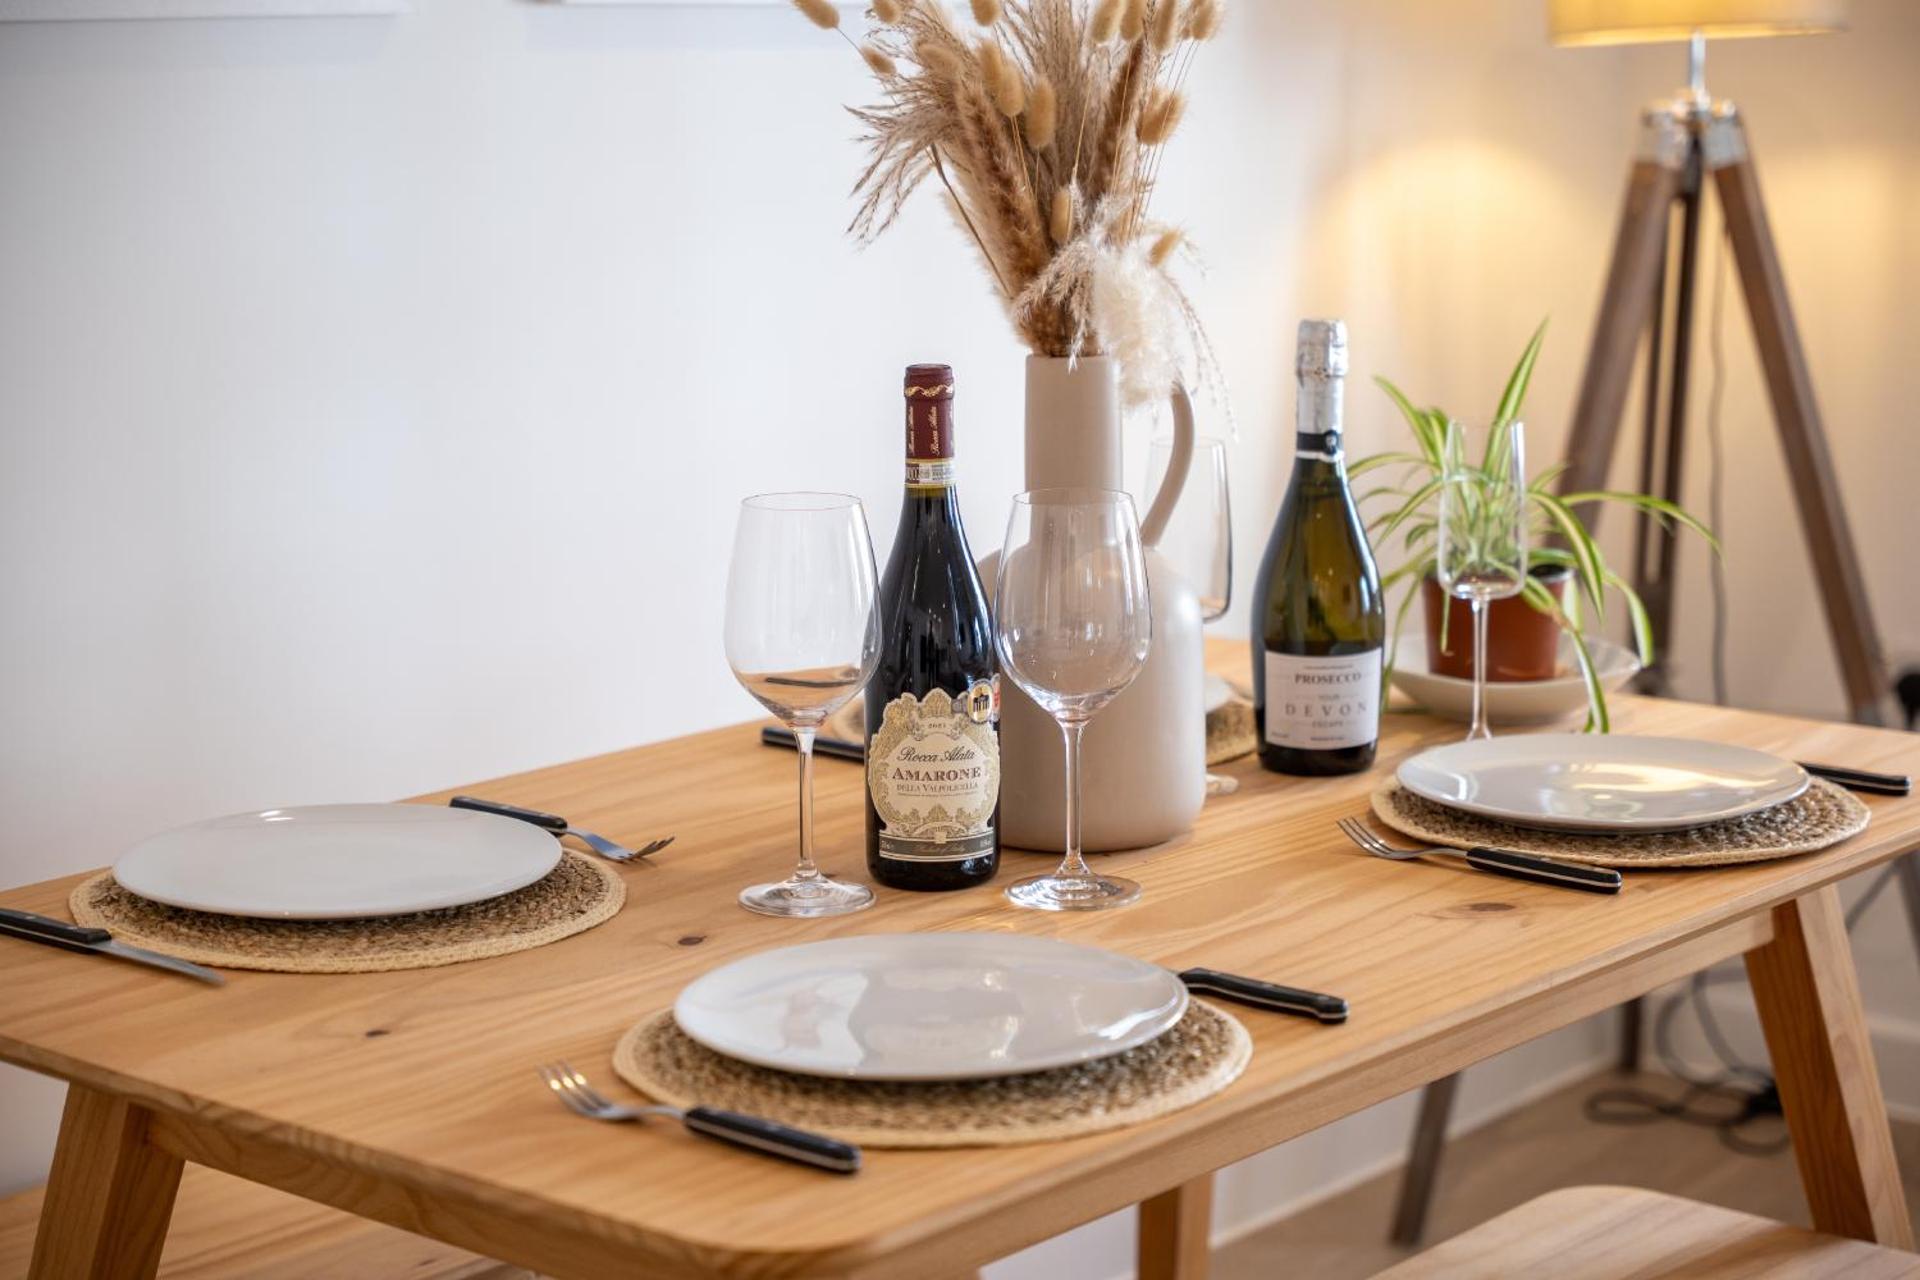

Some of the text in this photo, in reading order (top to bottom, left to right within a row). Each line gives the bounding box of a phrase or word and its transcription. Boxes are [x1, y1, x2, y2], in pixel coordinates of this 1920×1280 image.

[1295, 673, 1361, 684] PROSECCO
[1285, 702, 1367, 717] DEVON
[892, 767, 982, 781] AMARONE
